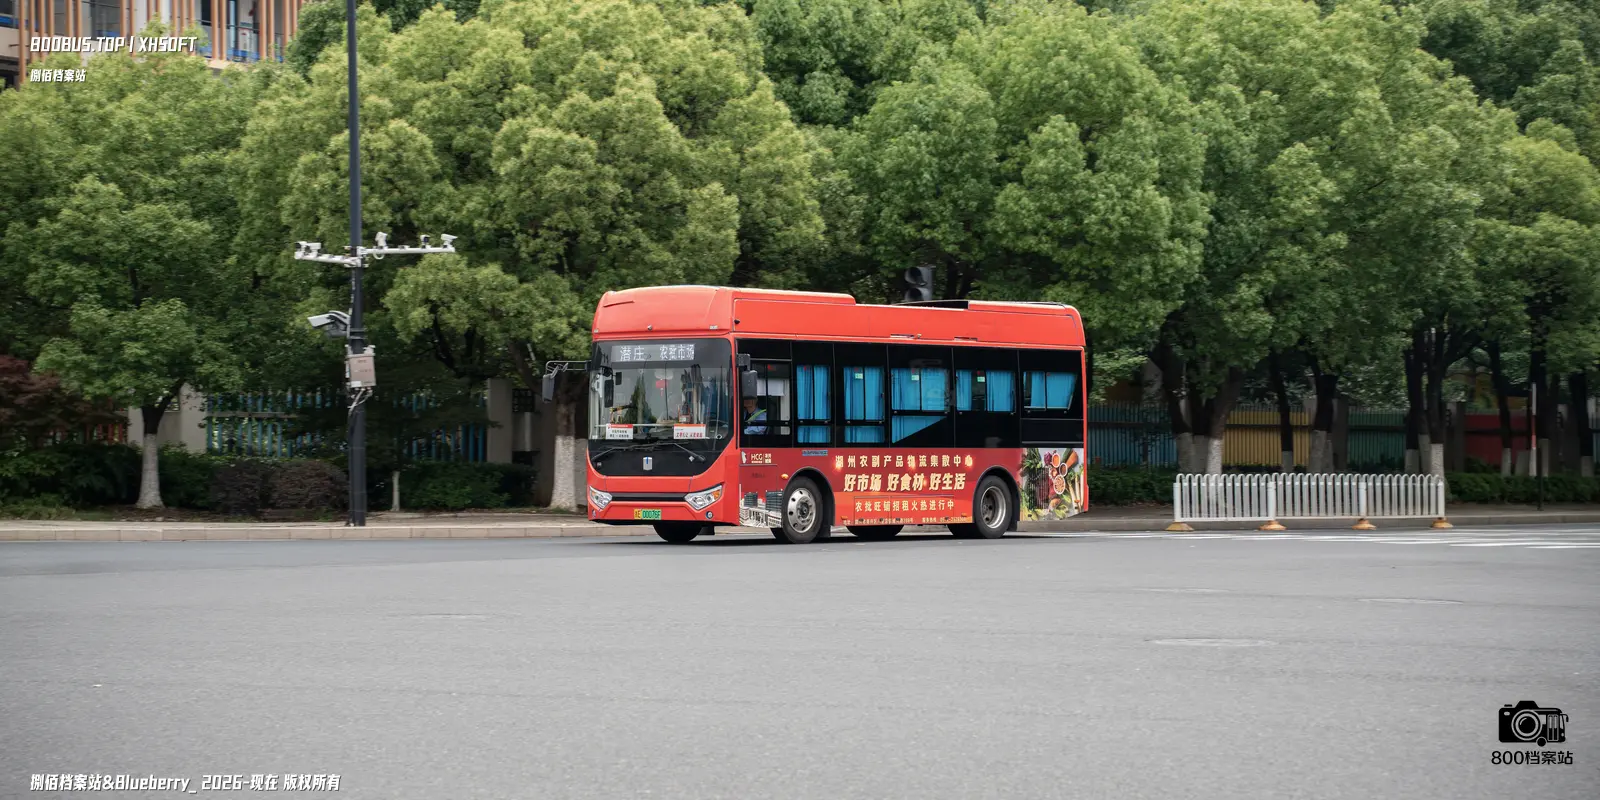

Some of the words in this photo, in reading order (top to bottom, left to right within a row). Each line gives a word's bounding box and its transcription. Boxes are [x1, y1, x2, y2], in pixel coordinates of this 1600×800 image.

[835, 455, 973, 468] 湖州农副产品物流集散中心
[843, 474, 882, 492] 好市场
[887, 473, 925, 491] 好食材
[929, 473, 966, 490] 好生活
